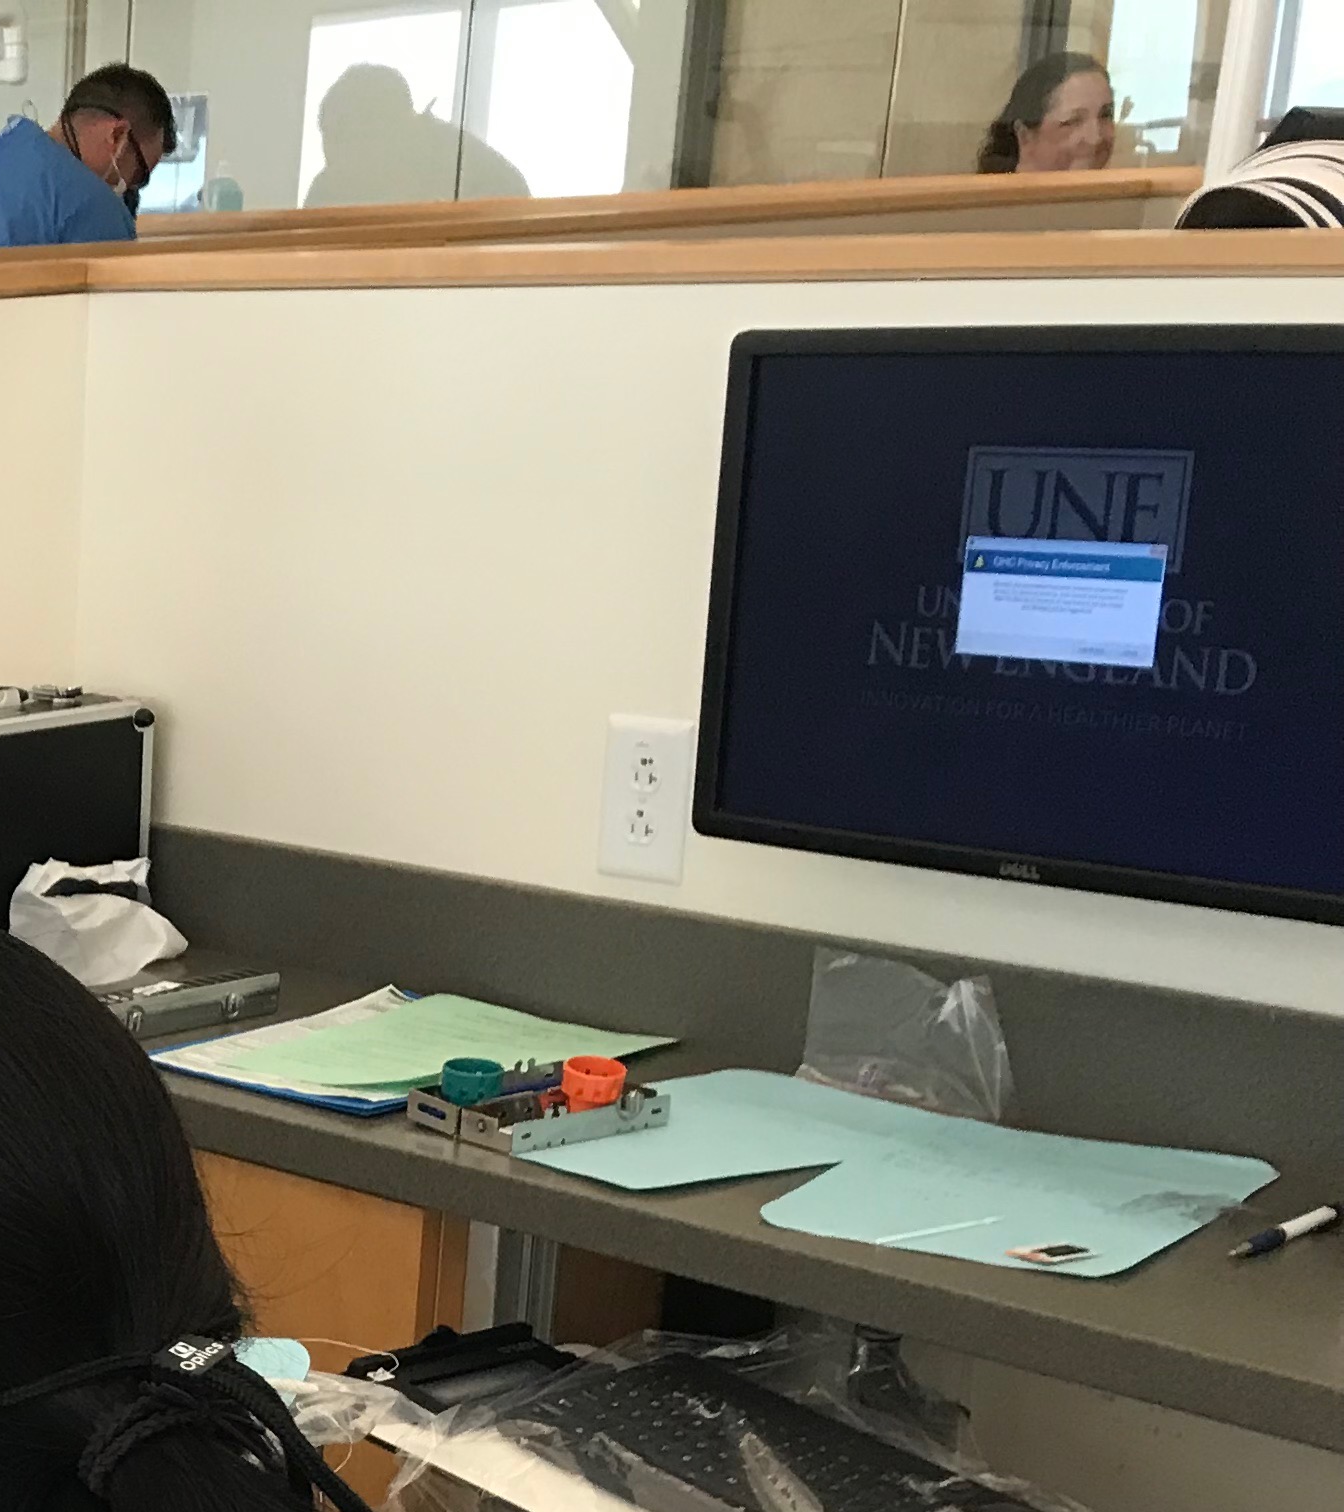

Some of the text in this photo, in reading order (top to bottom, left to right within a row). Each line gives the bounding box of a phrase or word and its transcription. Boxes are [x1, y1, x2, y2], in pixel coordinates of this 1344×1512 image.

[982, 467, 1166, 545] UNE
[1162, 598, 1215, 634] OF
[984, 698, 1026, 720] FOR
[1027, 702, 1044, 722] A
[1046, 702, 1162, 733] HEALTHIER
[1166, 715, 1251, 742] PLANET
[179, 1342, 224, 1371] Optics
